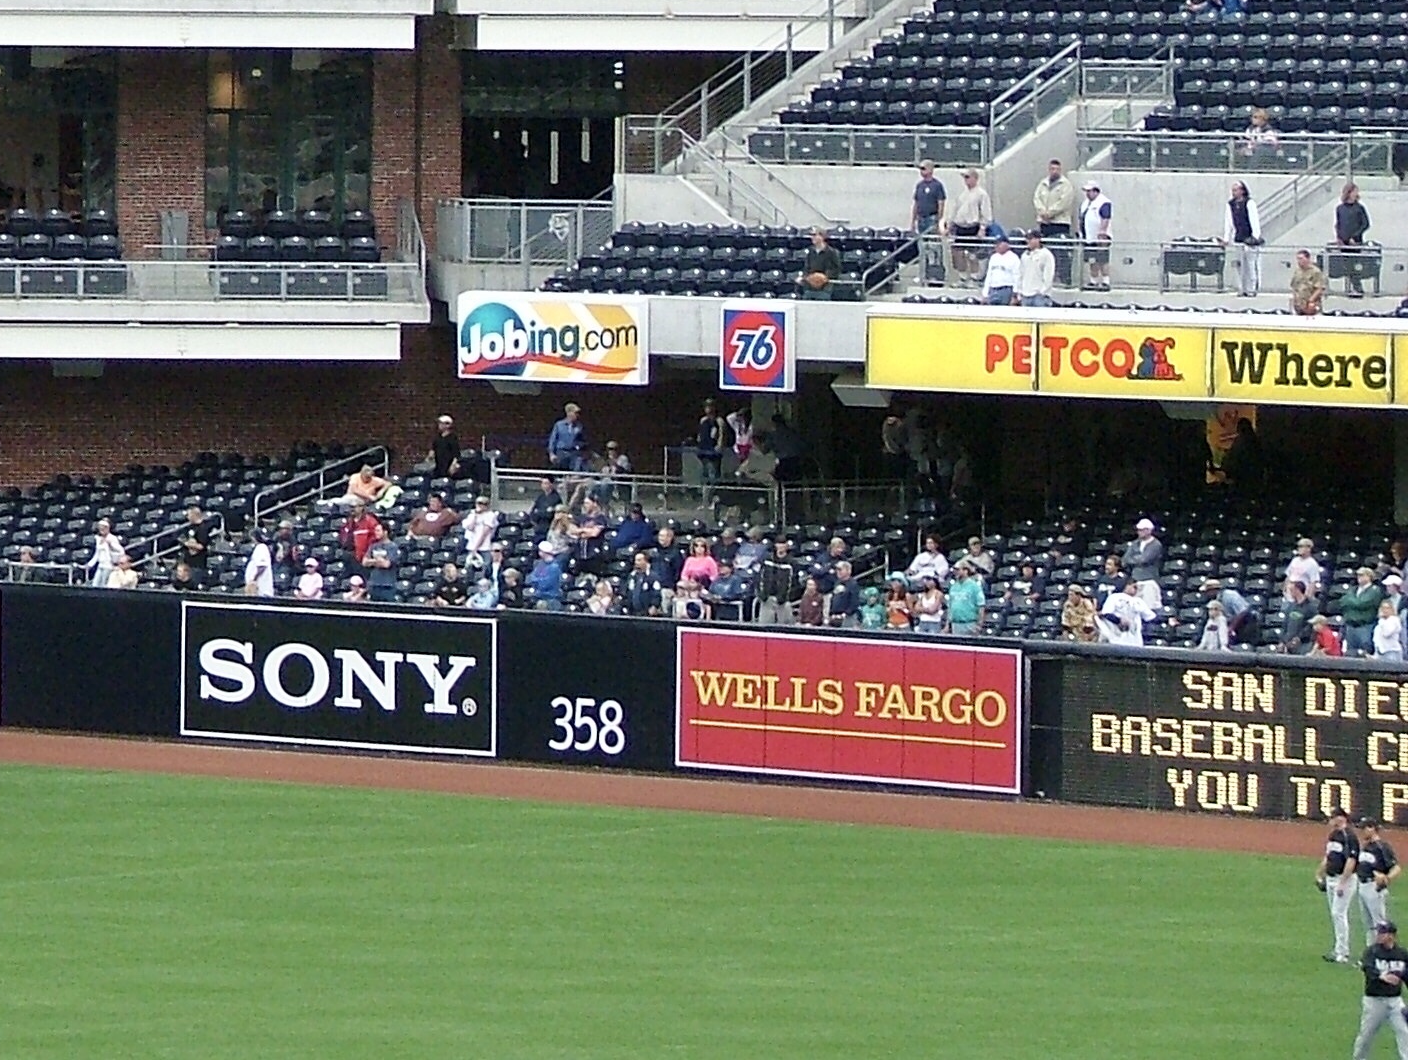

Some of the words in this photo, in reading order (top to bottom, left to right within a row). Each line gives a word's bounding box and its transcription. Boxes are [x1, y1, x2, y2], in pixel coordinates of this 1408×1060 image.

[459, 319, 638, 364] Jobing.com
[728, 324, 777, 371] 76
[984, 333, 1134, 379] PETCO
[1220, 339, 1389, 389] Where
[689, 670, 843, 716] WELLS
[853, 681, 1008, 728] FARGO
[1181, 669, 1275, 714] SAN
[547, 695, 626, 755] 358
[1091, 713, 1336, 768] BASEBALL
[1166, 767, 1259, 813] YOU
[1289, 775, 1352, 818] TO
